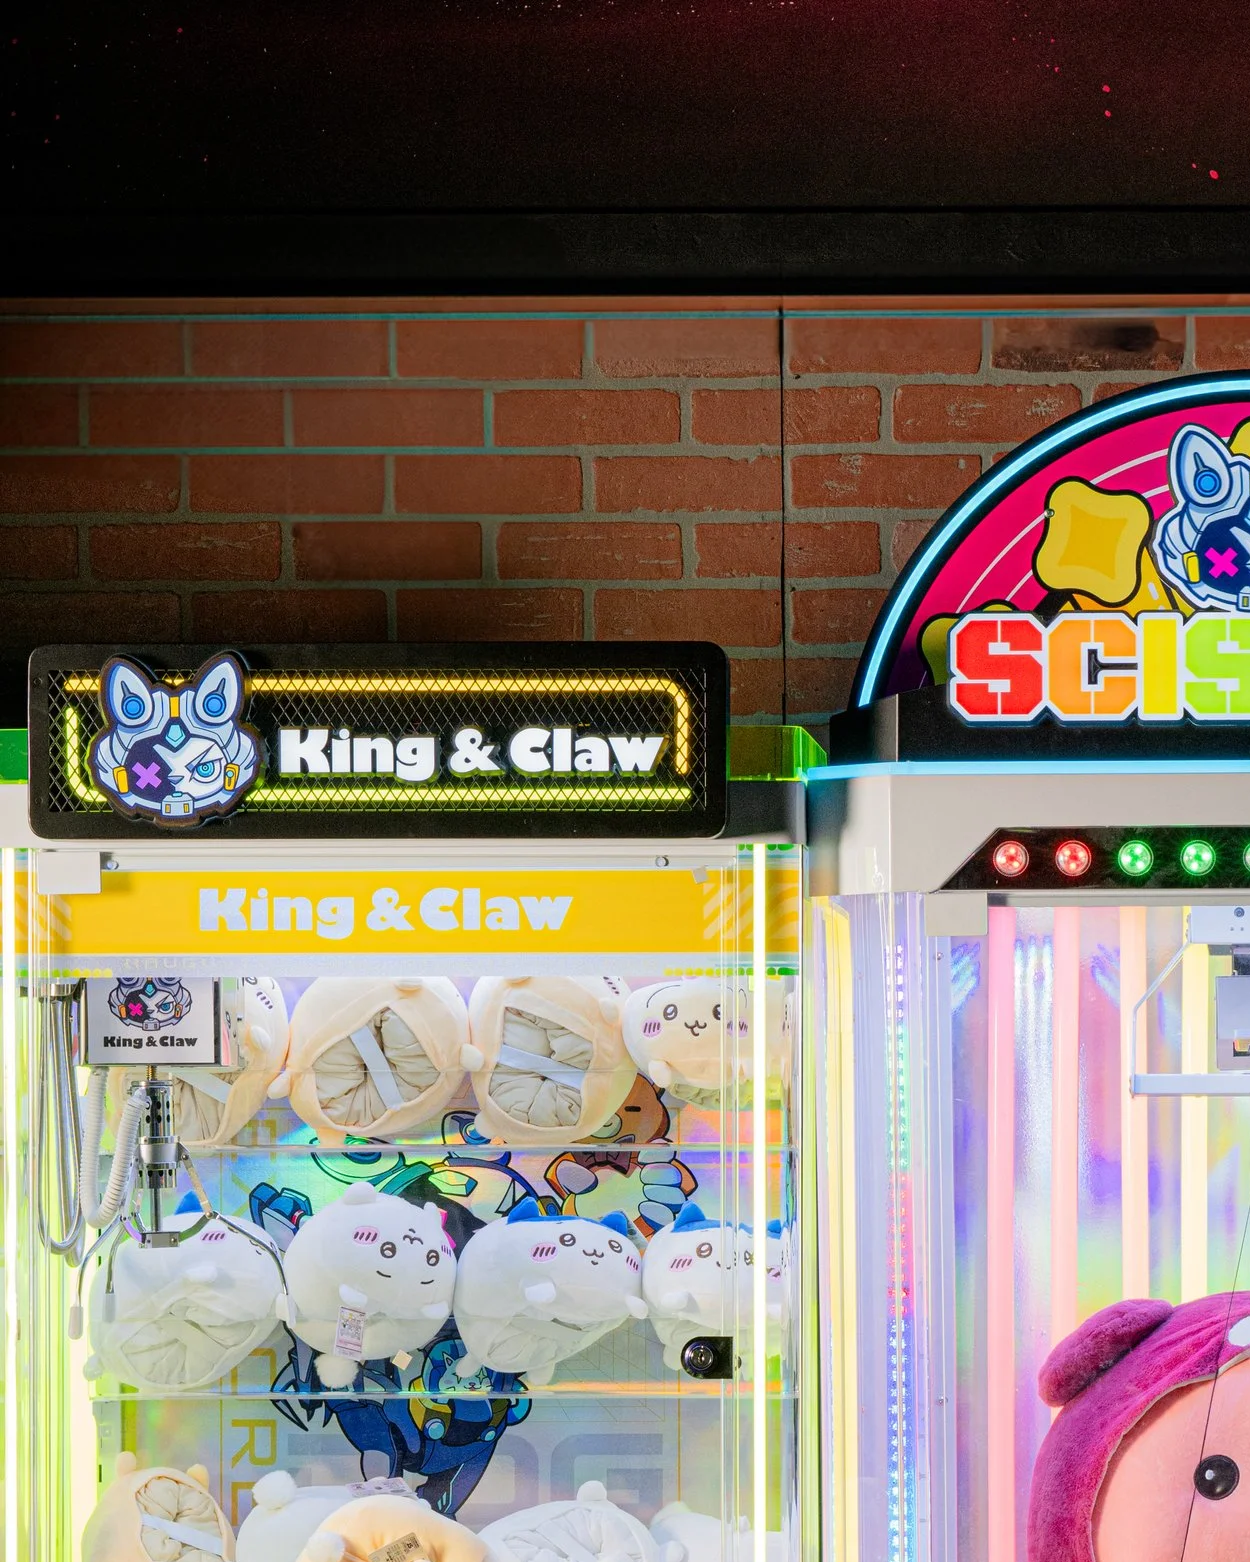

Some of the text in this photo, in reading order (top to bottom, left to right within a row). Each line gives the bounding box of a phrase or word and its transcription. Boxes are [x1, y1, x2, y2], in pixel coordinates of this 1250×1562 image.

[278, 727, 668, 783] King & Claw
[198, 887, 574, 940] King & Claw
[103, 1035, 198, 1048] King & Claw
